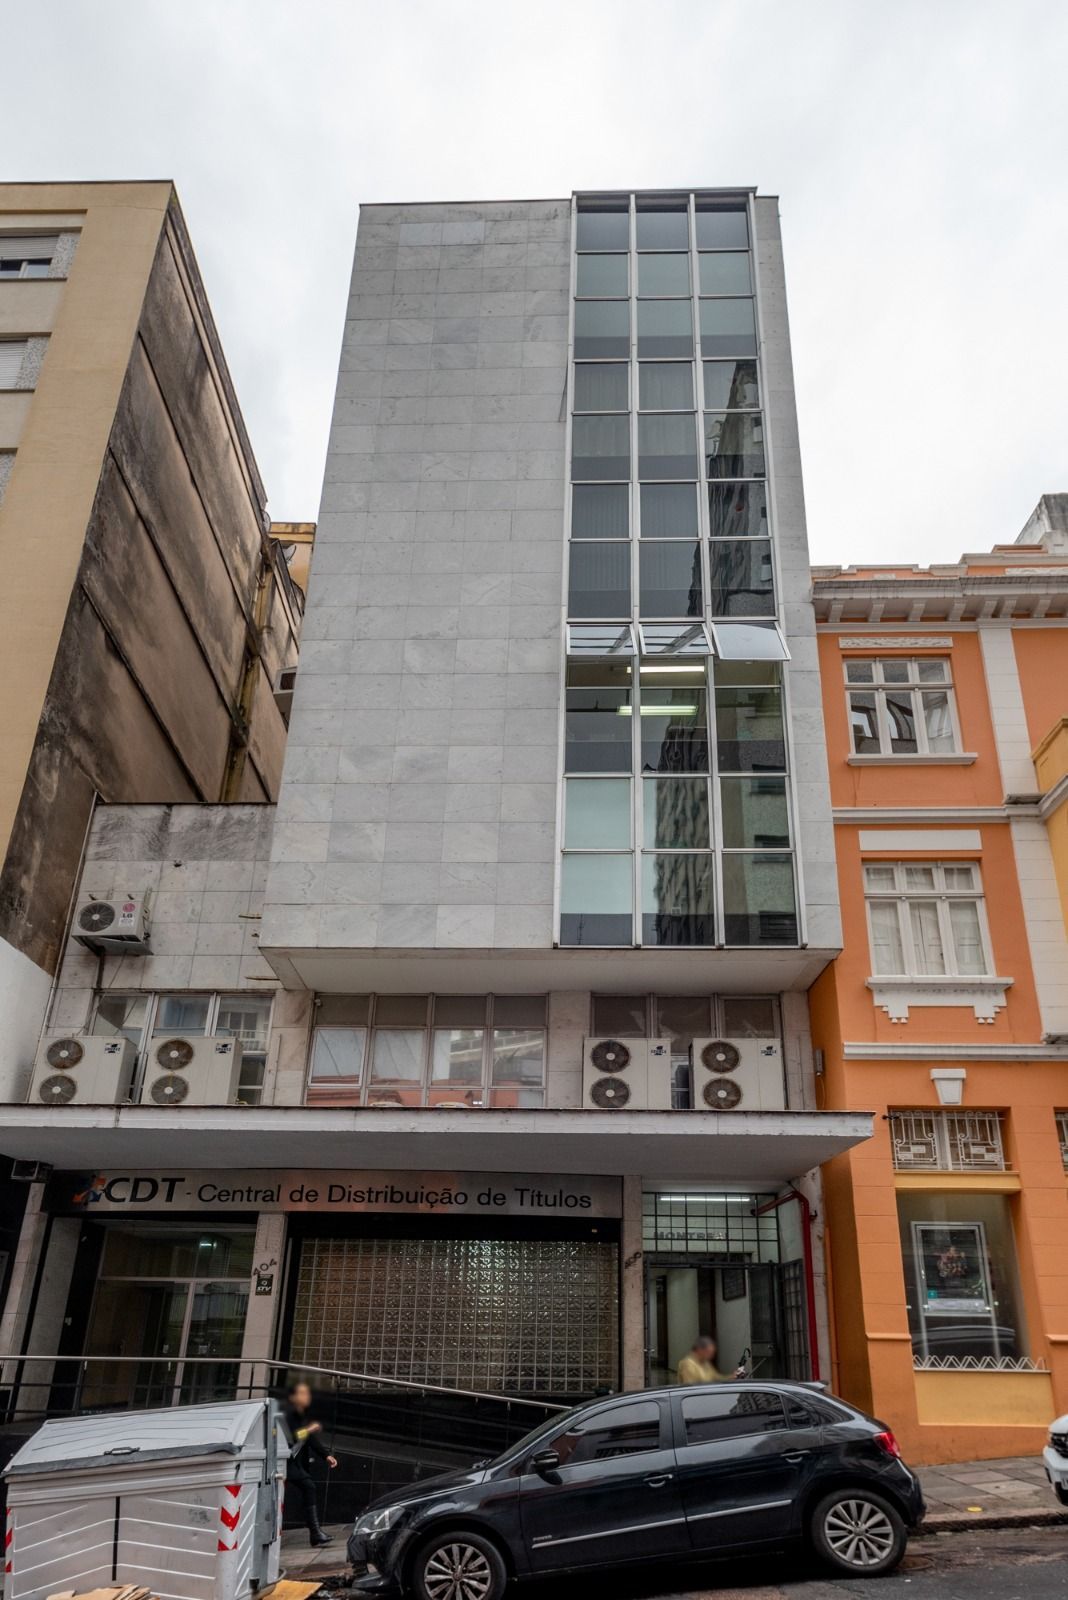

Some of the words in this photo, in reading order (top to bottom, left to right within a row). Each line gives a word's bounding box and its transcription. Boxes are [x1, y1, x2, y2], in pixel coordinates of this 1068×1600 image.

[104, 1177, 185, 1203] CDT
[197, 1184, 281, 1203] Central
[289, 1184, 319, 1203] de
[327, 1184, 469, 1208] Distribuição
[476, 1187, 507, 1207] de
[514, 1188, 592, 1209] Títulos
[253, 1258, 278, 1276] 404
